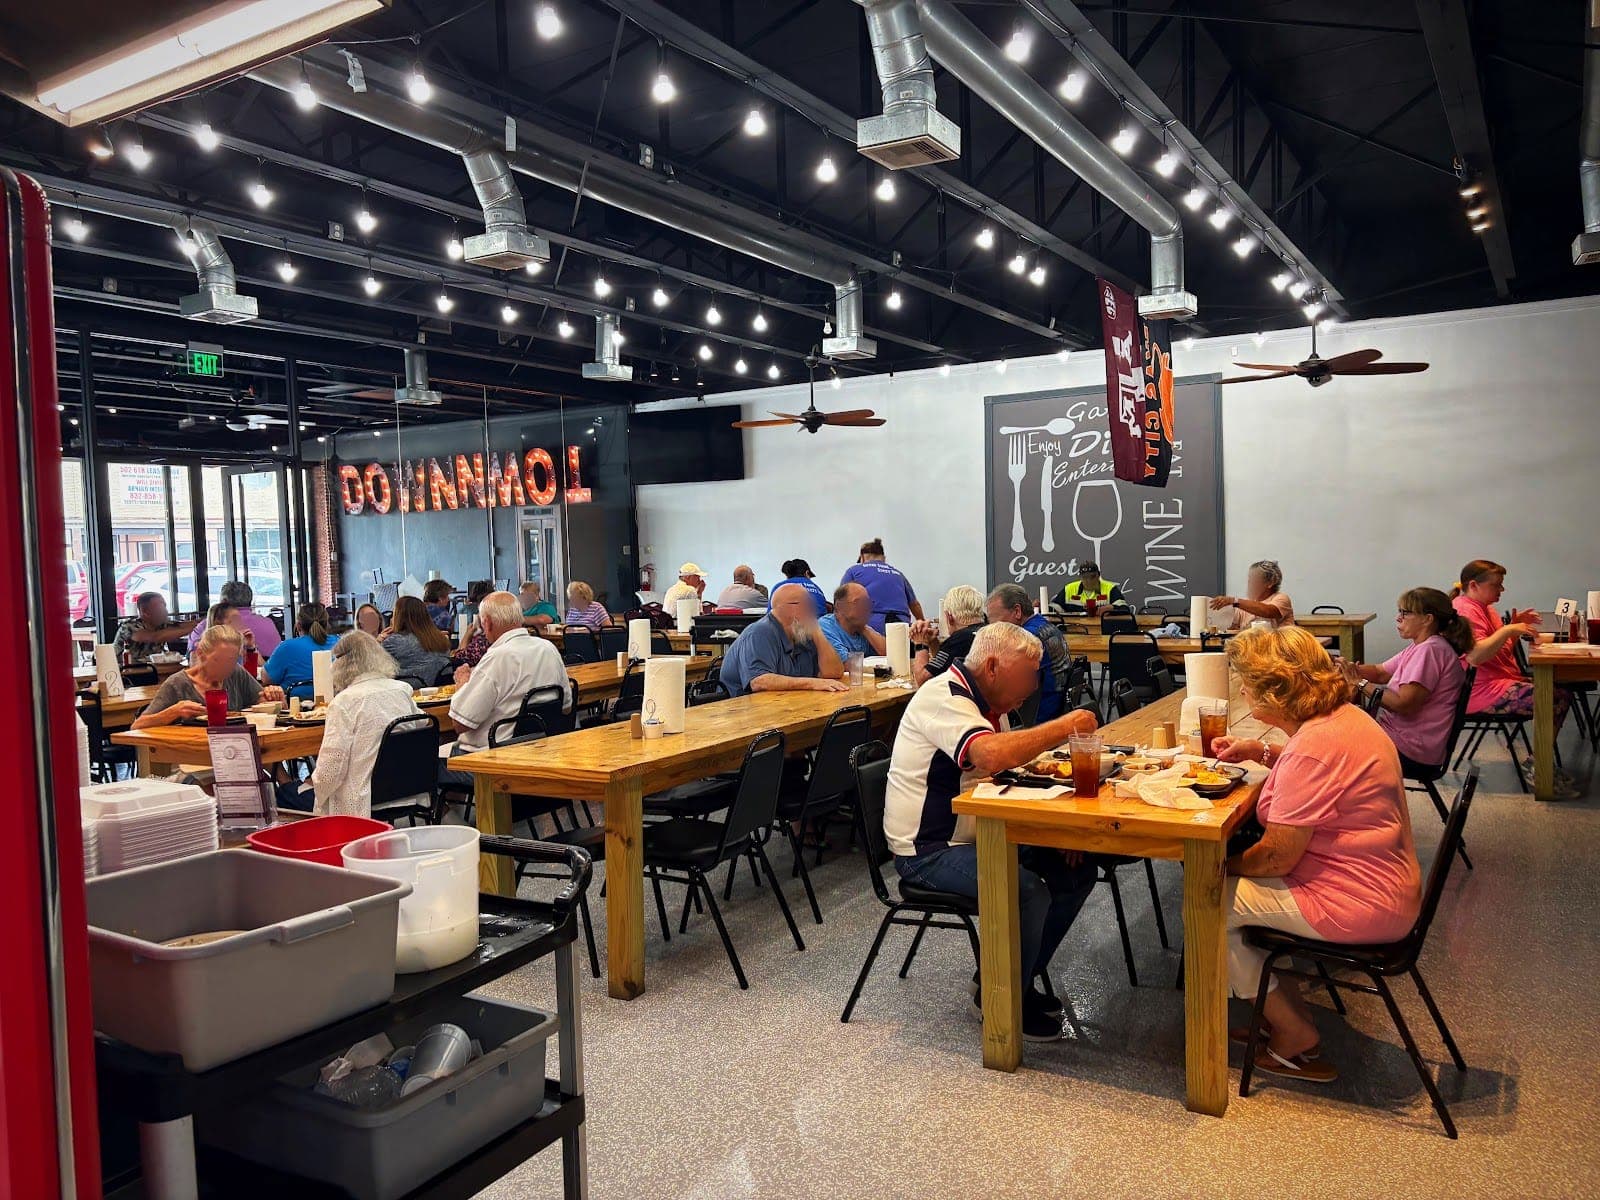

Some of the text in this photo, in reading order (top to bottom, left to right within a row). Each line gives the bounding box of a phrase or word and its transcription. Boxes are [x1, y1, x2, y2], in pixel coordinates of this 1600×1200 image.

[194, 353, 218, 375] EXIT
[1066, 401, 1109, 422] Ga
[1028, 432, 1062, 457] Enjoy
[1069, 430, 1112, 458] Di
[1052, 459, 1115, 489] Enter
[1143, 498, 1186, 606] WINE
[1008, 554, 1080, 583] Guest
[1562, 602, 1569, 613] 3
